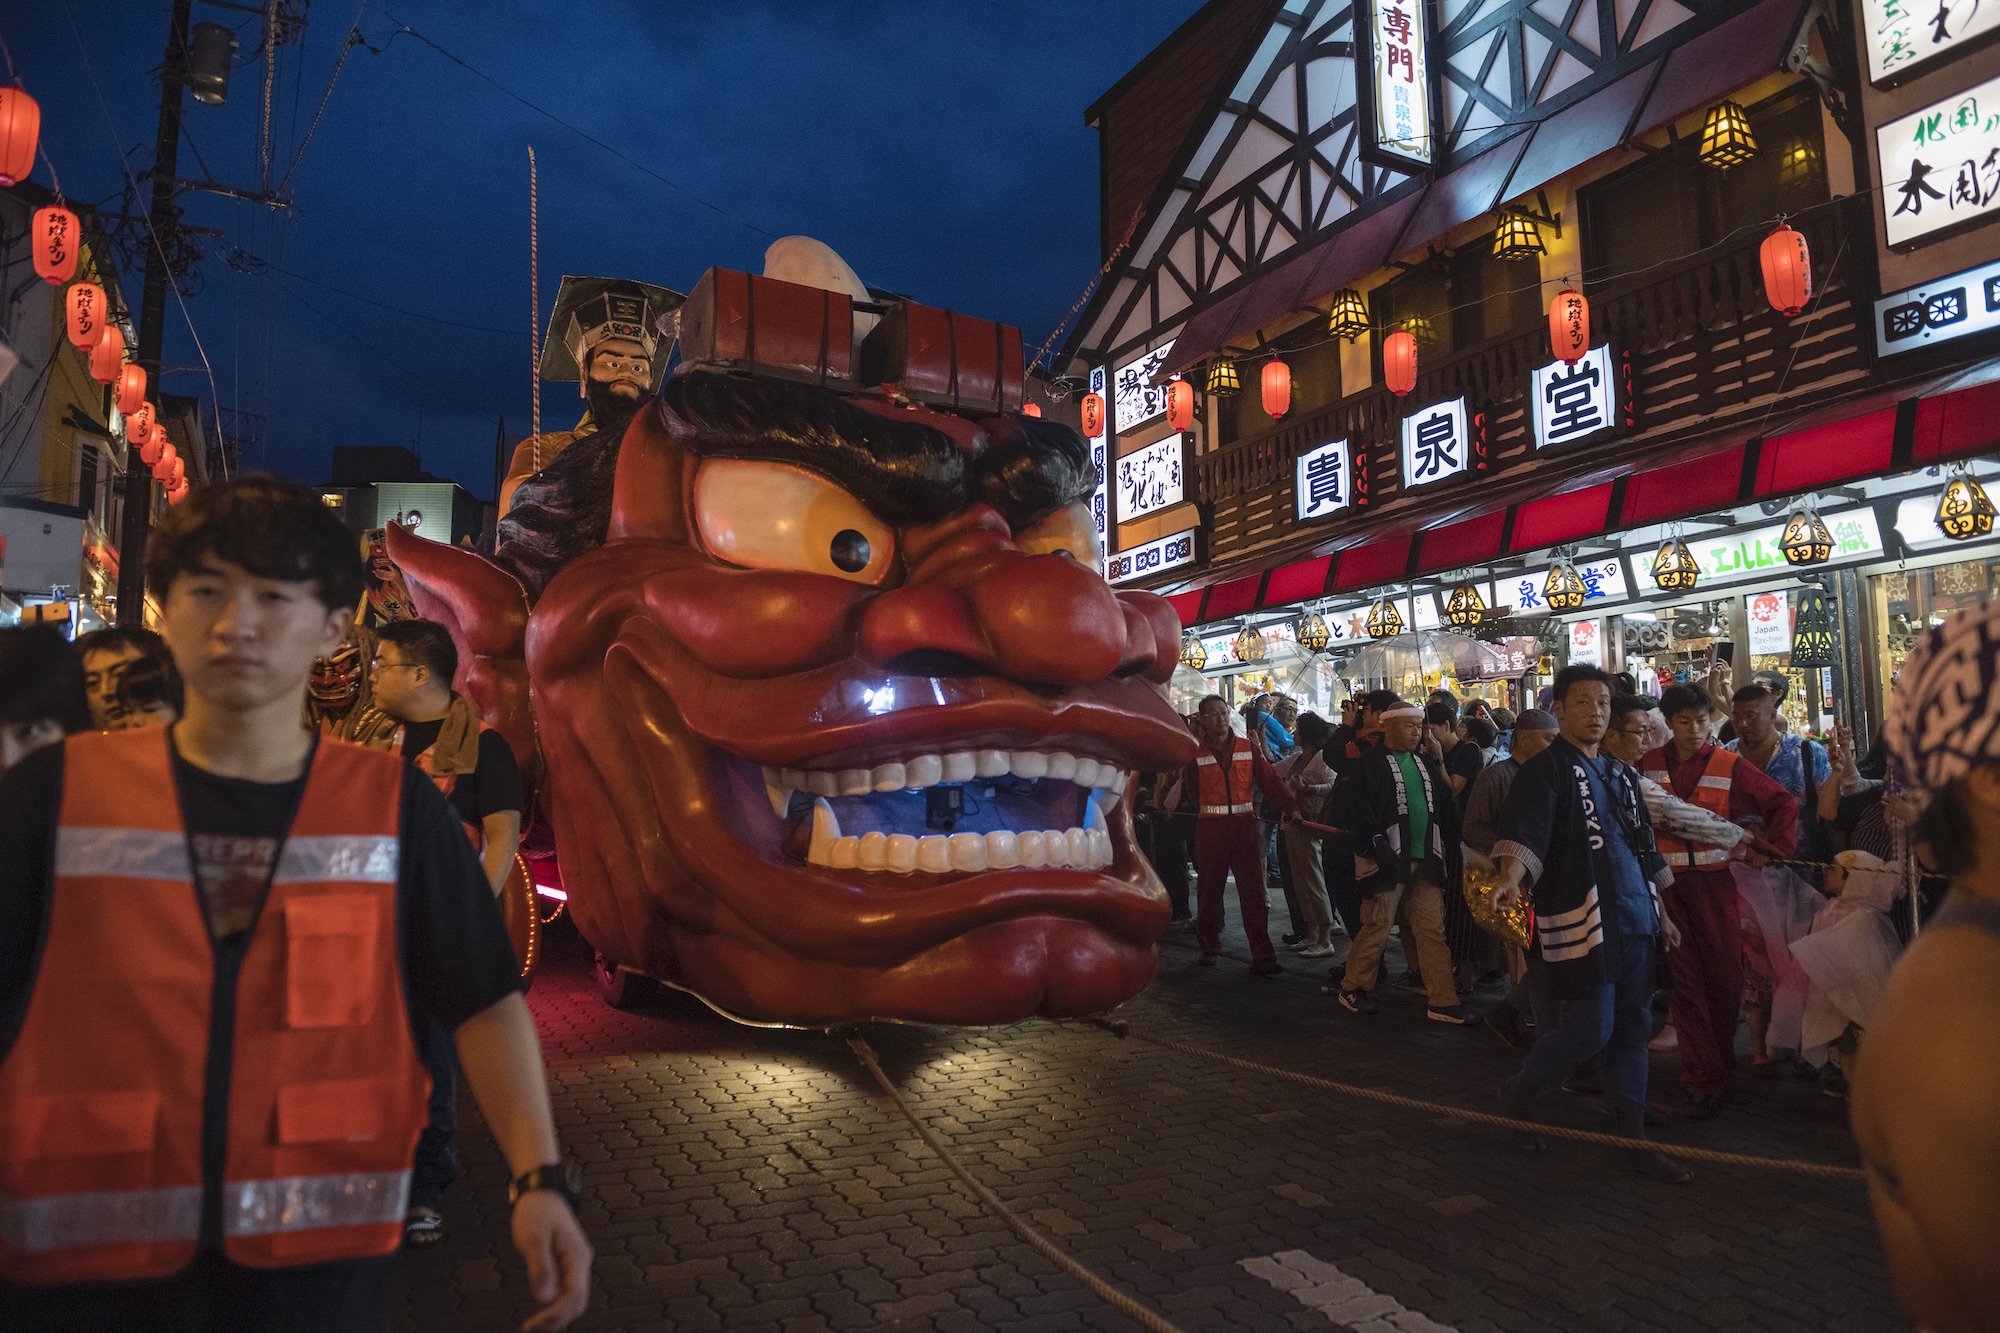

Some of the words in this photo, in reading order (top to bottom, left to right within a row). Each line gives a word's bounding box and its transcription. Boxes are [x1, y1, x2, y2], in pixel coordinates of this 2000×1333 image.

[1394, 85, 1413, 142] 貴泉堂
[48, 213, 69, 265] 地獄まつり
[77, 288, 93, 334] 地獄まつり
[613, 301, 640, 320] 王
[1567, 298, 1583, 349] 地獄まつり
[1307, 453, 1343, 513] 貴
[1414, 413, 1459, 478] 泉
[1546, 361, 1602, 440] 堂
